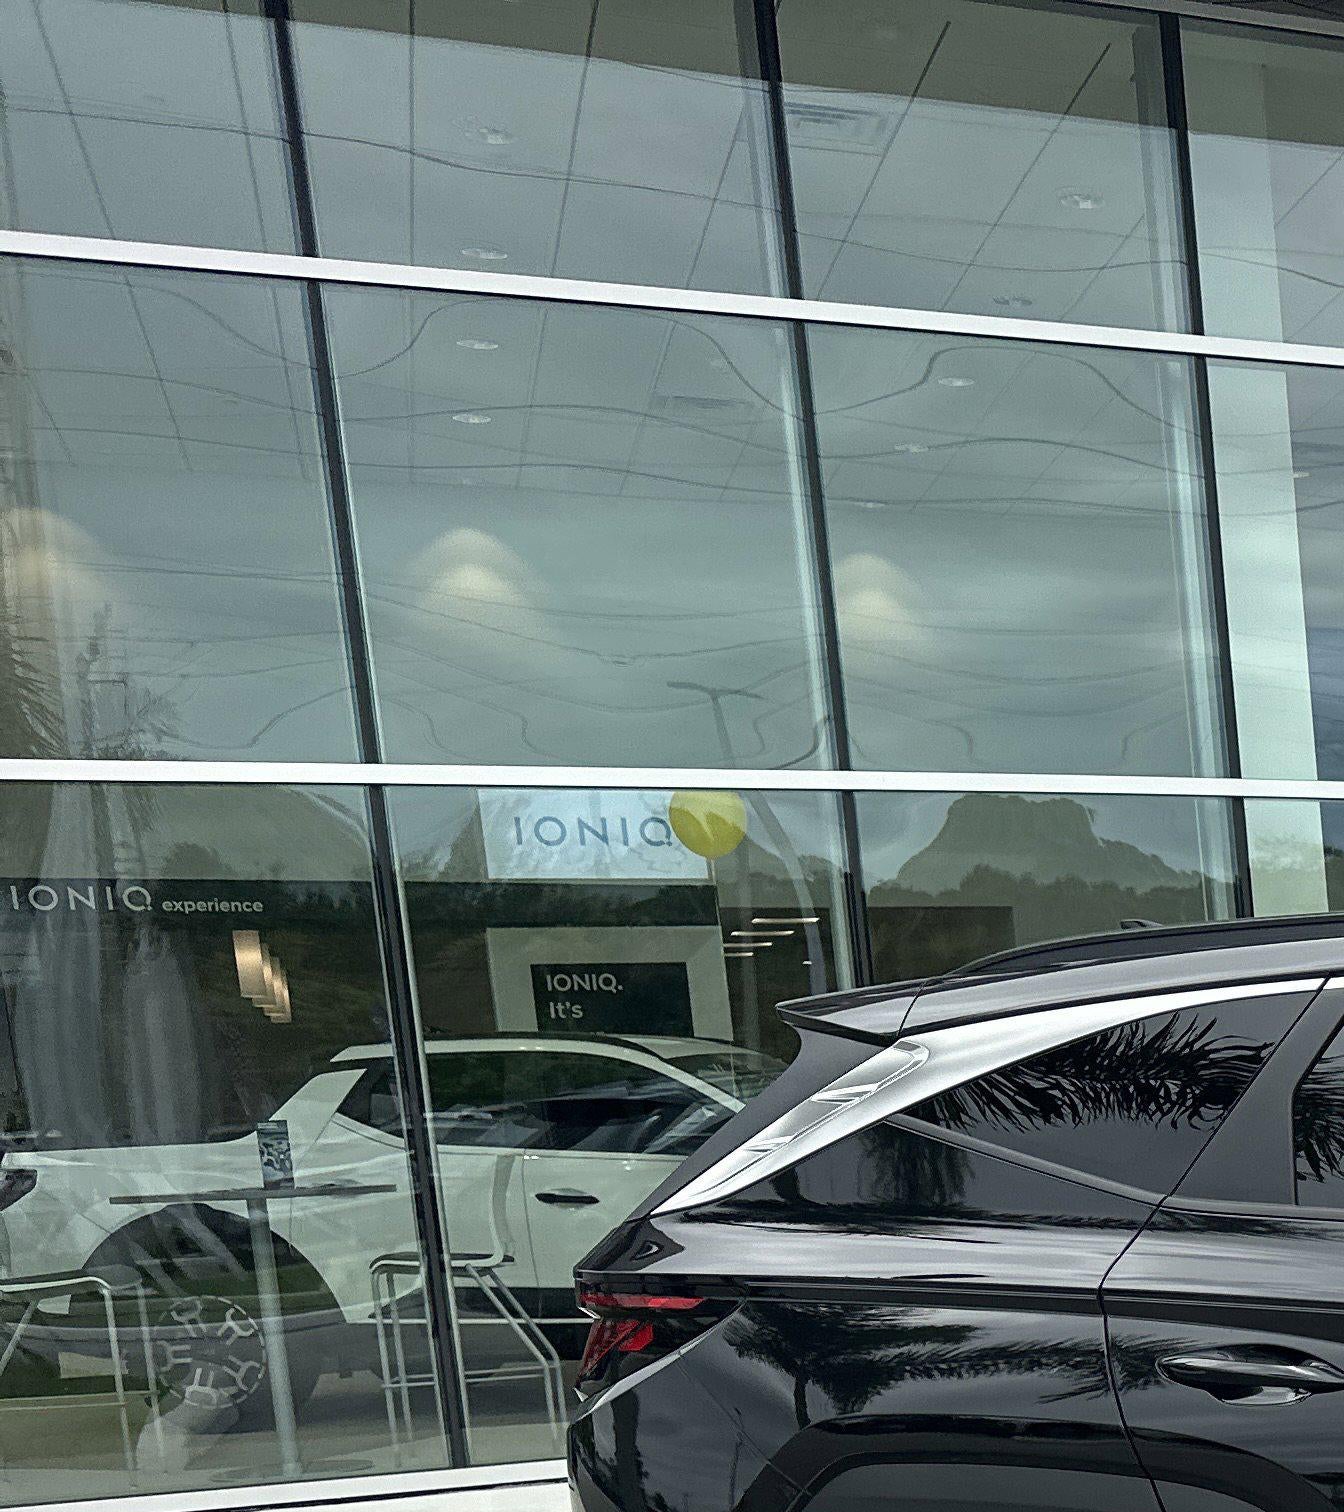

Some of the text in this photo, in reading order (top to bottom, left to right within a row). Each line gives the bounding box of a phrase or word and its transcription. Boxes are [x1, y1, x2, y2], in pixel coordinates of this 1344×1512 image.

[513, 816, 673, 847] IONIQ
[10, 885, 264, 914] IONIQ experience
[546, 973, 624, 993] IONIQ.
[549, 1002, 584, 1020] It's
